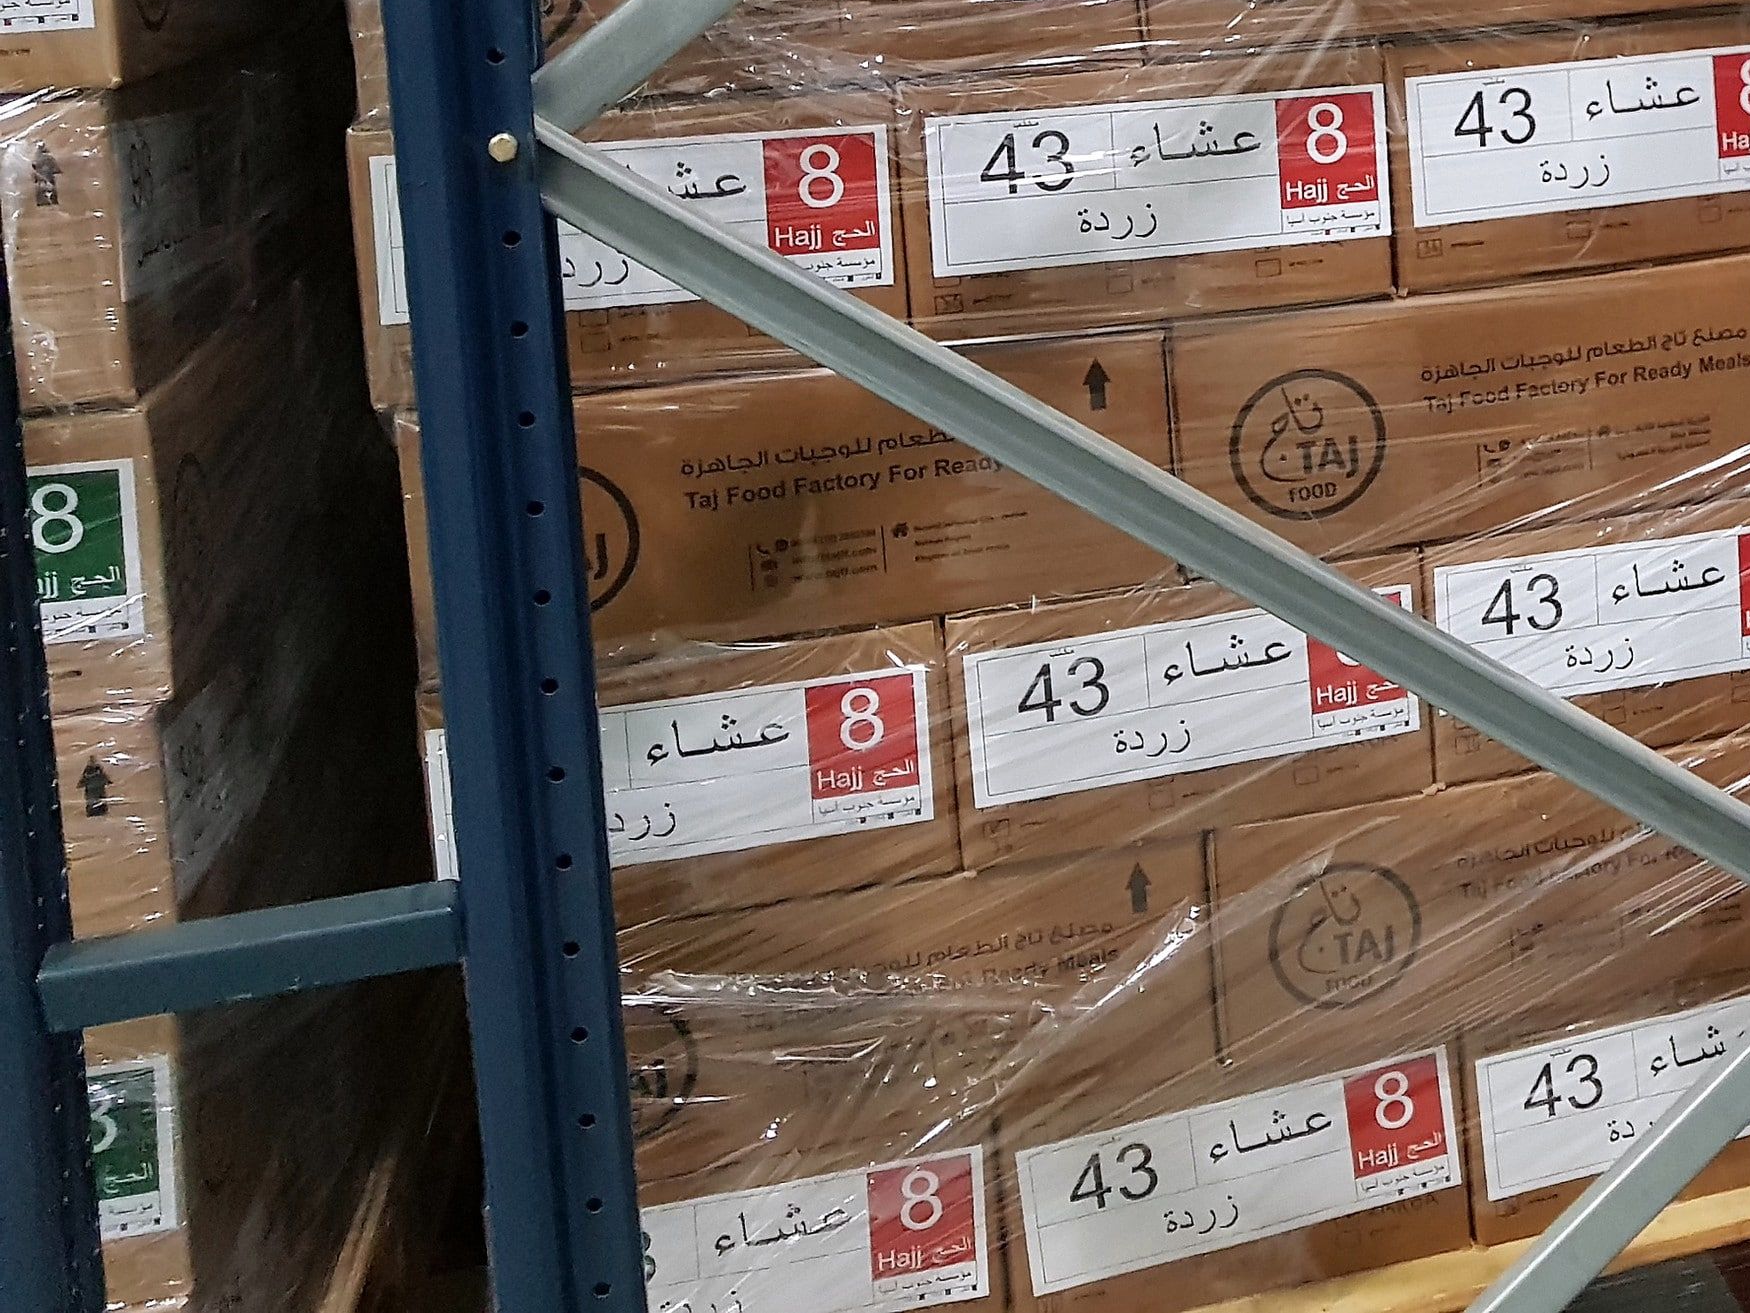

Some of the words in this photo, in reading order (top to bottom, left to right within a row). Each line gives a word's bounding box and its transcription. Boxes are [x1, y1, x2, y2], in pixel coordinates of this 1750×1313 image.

[1454, 86, 1536, 149] 43
[1585, 75, 1701, 123] عشاء
[1129, 120, 1262, 170] عشاء
[1305, 102, 1348, 165] 8
[799, 144, 844, 209] 8
[979, 129, 1076, 195] 43
[1540, 153, 1612, 189] زردة
[1286, 179, 1329, 204] Hajj
[1336, 175, 1375, 202] الحج
[774, 226, 823, 251] Hajj
[832, 220, 876, 247] الحج
[1078, 202, 1159, 240] زردة
[1586, 335, 1657, 364] الطعام
[1660, 330, 1687, 351] تاج
[1693, 326, 1747, 348] مصنع
[1421, 357, 1496, 384] الجاهزة
[1499, 345, 1582, 372] للوجبات
[1460, 386, 1510, 408] Food
[1515, 374, 1590, 399] Factory
[1595, 370, 1627, 389] For
[1632, 359, 1692, 381] Ready
[680, 449, 769, 479] الجاهزة
[774, 436, 872, 466] للوجبات
[1295, 438, 1362, 473] TAJ
[684, 491, 720, 511] Taj
[727, 480, 786, 506] Food
[794, 469, 882, 497] Factory
[889, 461, 927, 484] For
[1289, 482, 1339, 503] FOOD
[31, 483, 84, 554] 8
[71, 565, 121, 595] الحج
[1611, 559, 1726, 607] عشاء
[1481, 573, 1563, 636] 43
[1162, 634, 1292, 687] عشاء
[1565, 639, 1635, 673] زردة
[1017, 656, 1111, 724] 43
[1316, 684, 1358, 708] Hajj
[838, 686, 885, 752] 8
[1114, 718, 1192, 759] زردة
[645, 713, 790, 767] عشاء
[816, 768, 864, 794] Hajj
[872, 760, 914, 789] الحج
[1332, 923, 1396, 966] TAJ
[1649, 1025, 1727, 1079] شاء
[1374, 1070, 1414, 1130] 8
[1524, 1053, 1605, 1120] 43
[1208, 1108, 1333, 1166] عشاء
[1406, 1131, 1444, 1160] الحج
[1608, 1117, 1634, 1143] دة
[1358, 1142, 1399, 1170] Hajj
[1070, 1142, 1159, 1211] 43
[900, 1168, 943, 1231] 8
[1164, 1192, 1240, 1236] زردة
[715, 1202, 850, 1257] عشاء
[878, 1247, 923, 1272] Hajj
[933, 1236, 972, 1264] الحج
